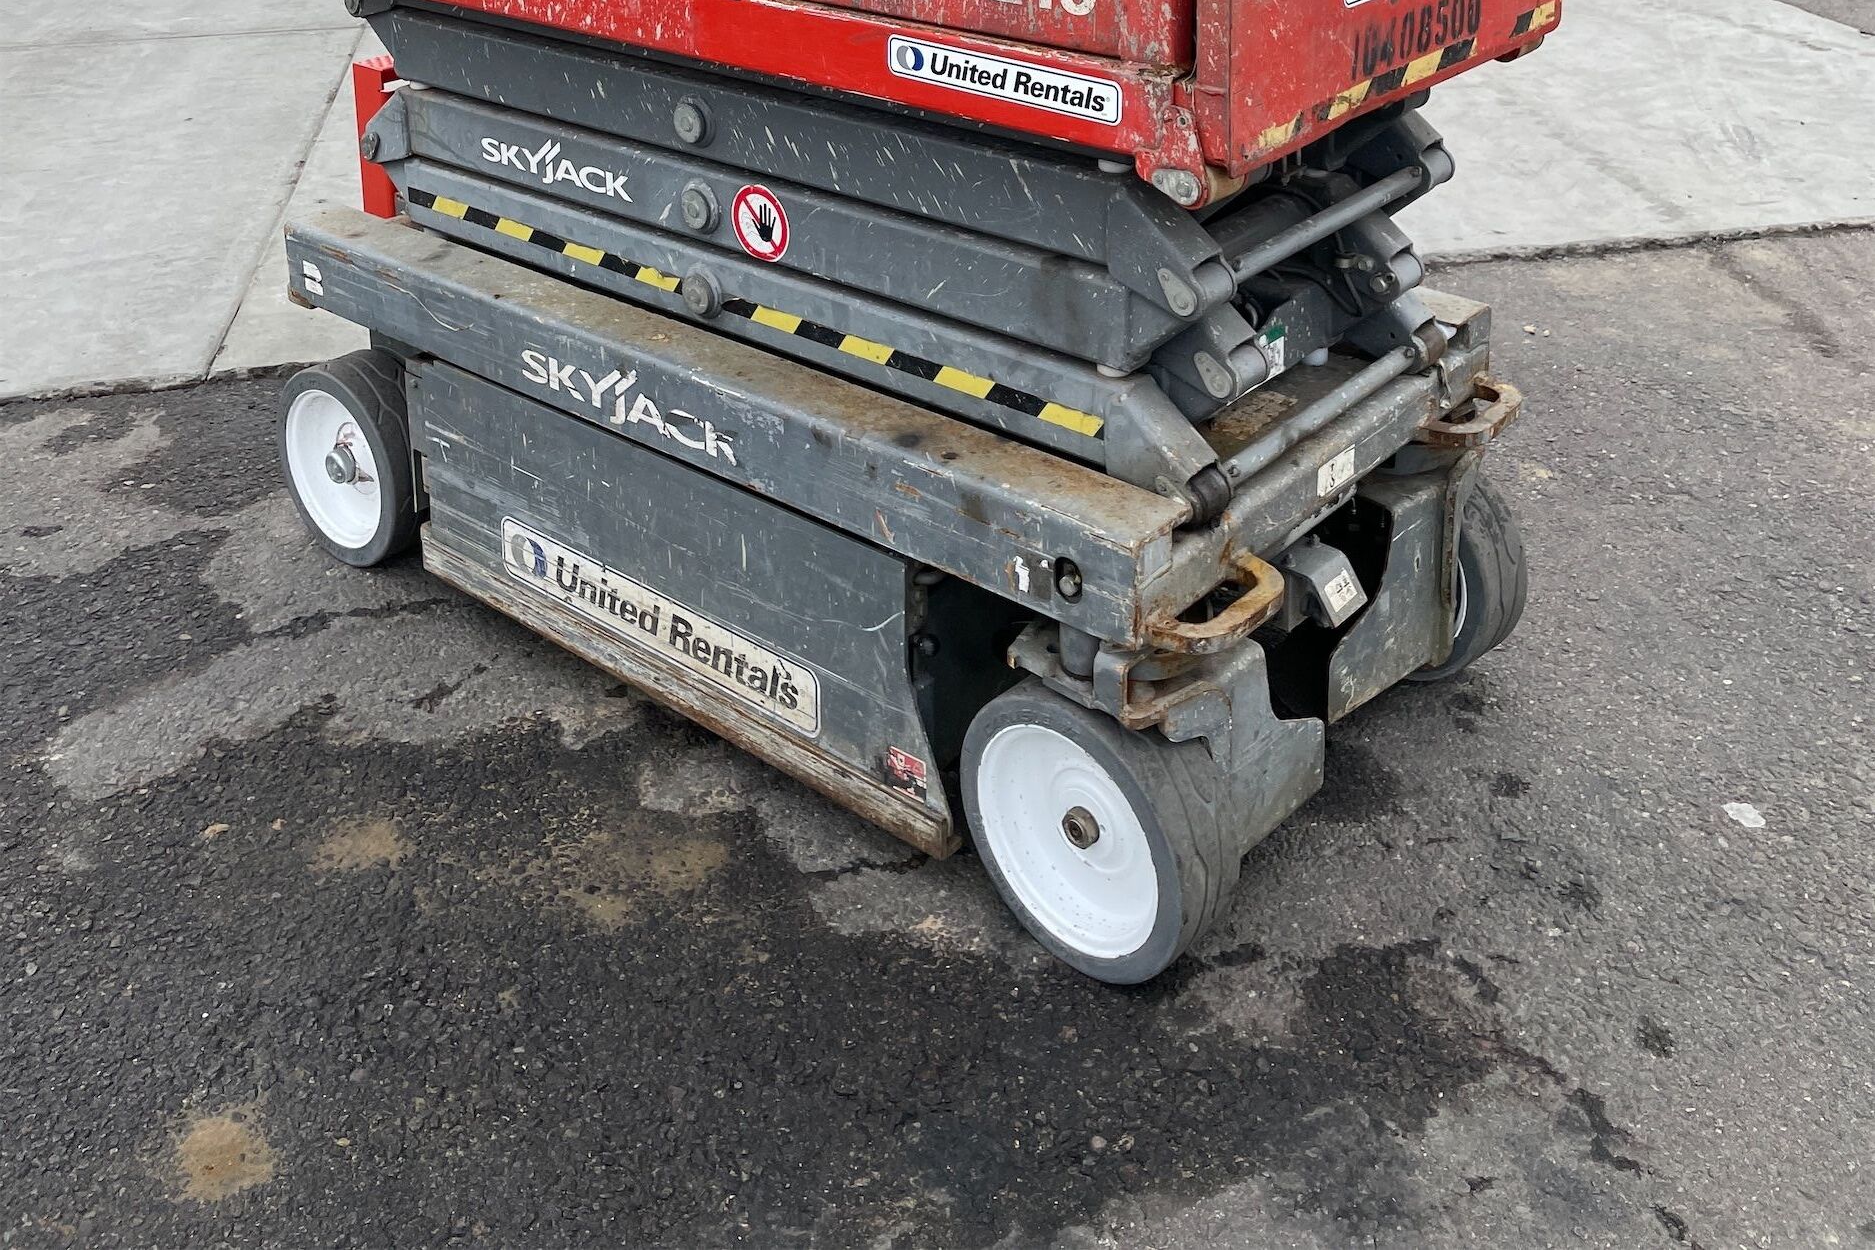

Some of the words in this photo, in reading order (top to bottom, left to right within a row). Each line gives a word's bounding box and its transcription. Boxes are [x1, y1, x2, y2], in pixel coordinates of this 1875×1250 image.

[930, 52, 1008, 91] United
[1013, 71, 1105, 113] Rentals
[480, 137, 634, 203] SKYJACK
[521, 349, 738, 467] SKYJACK
[556, 555, 661, 637] United
[669, 613, 799, 710] Rentals
